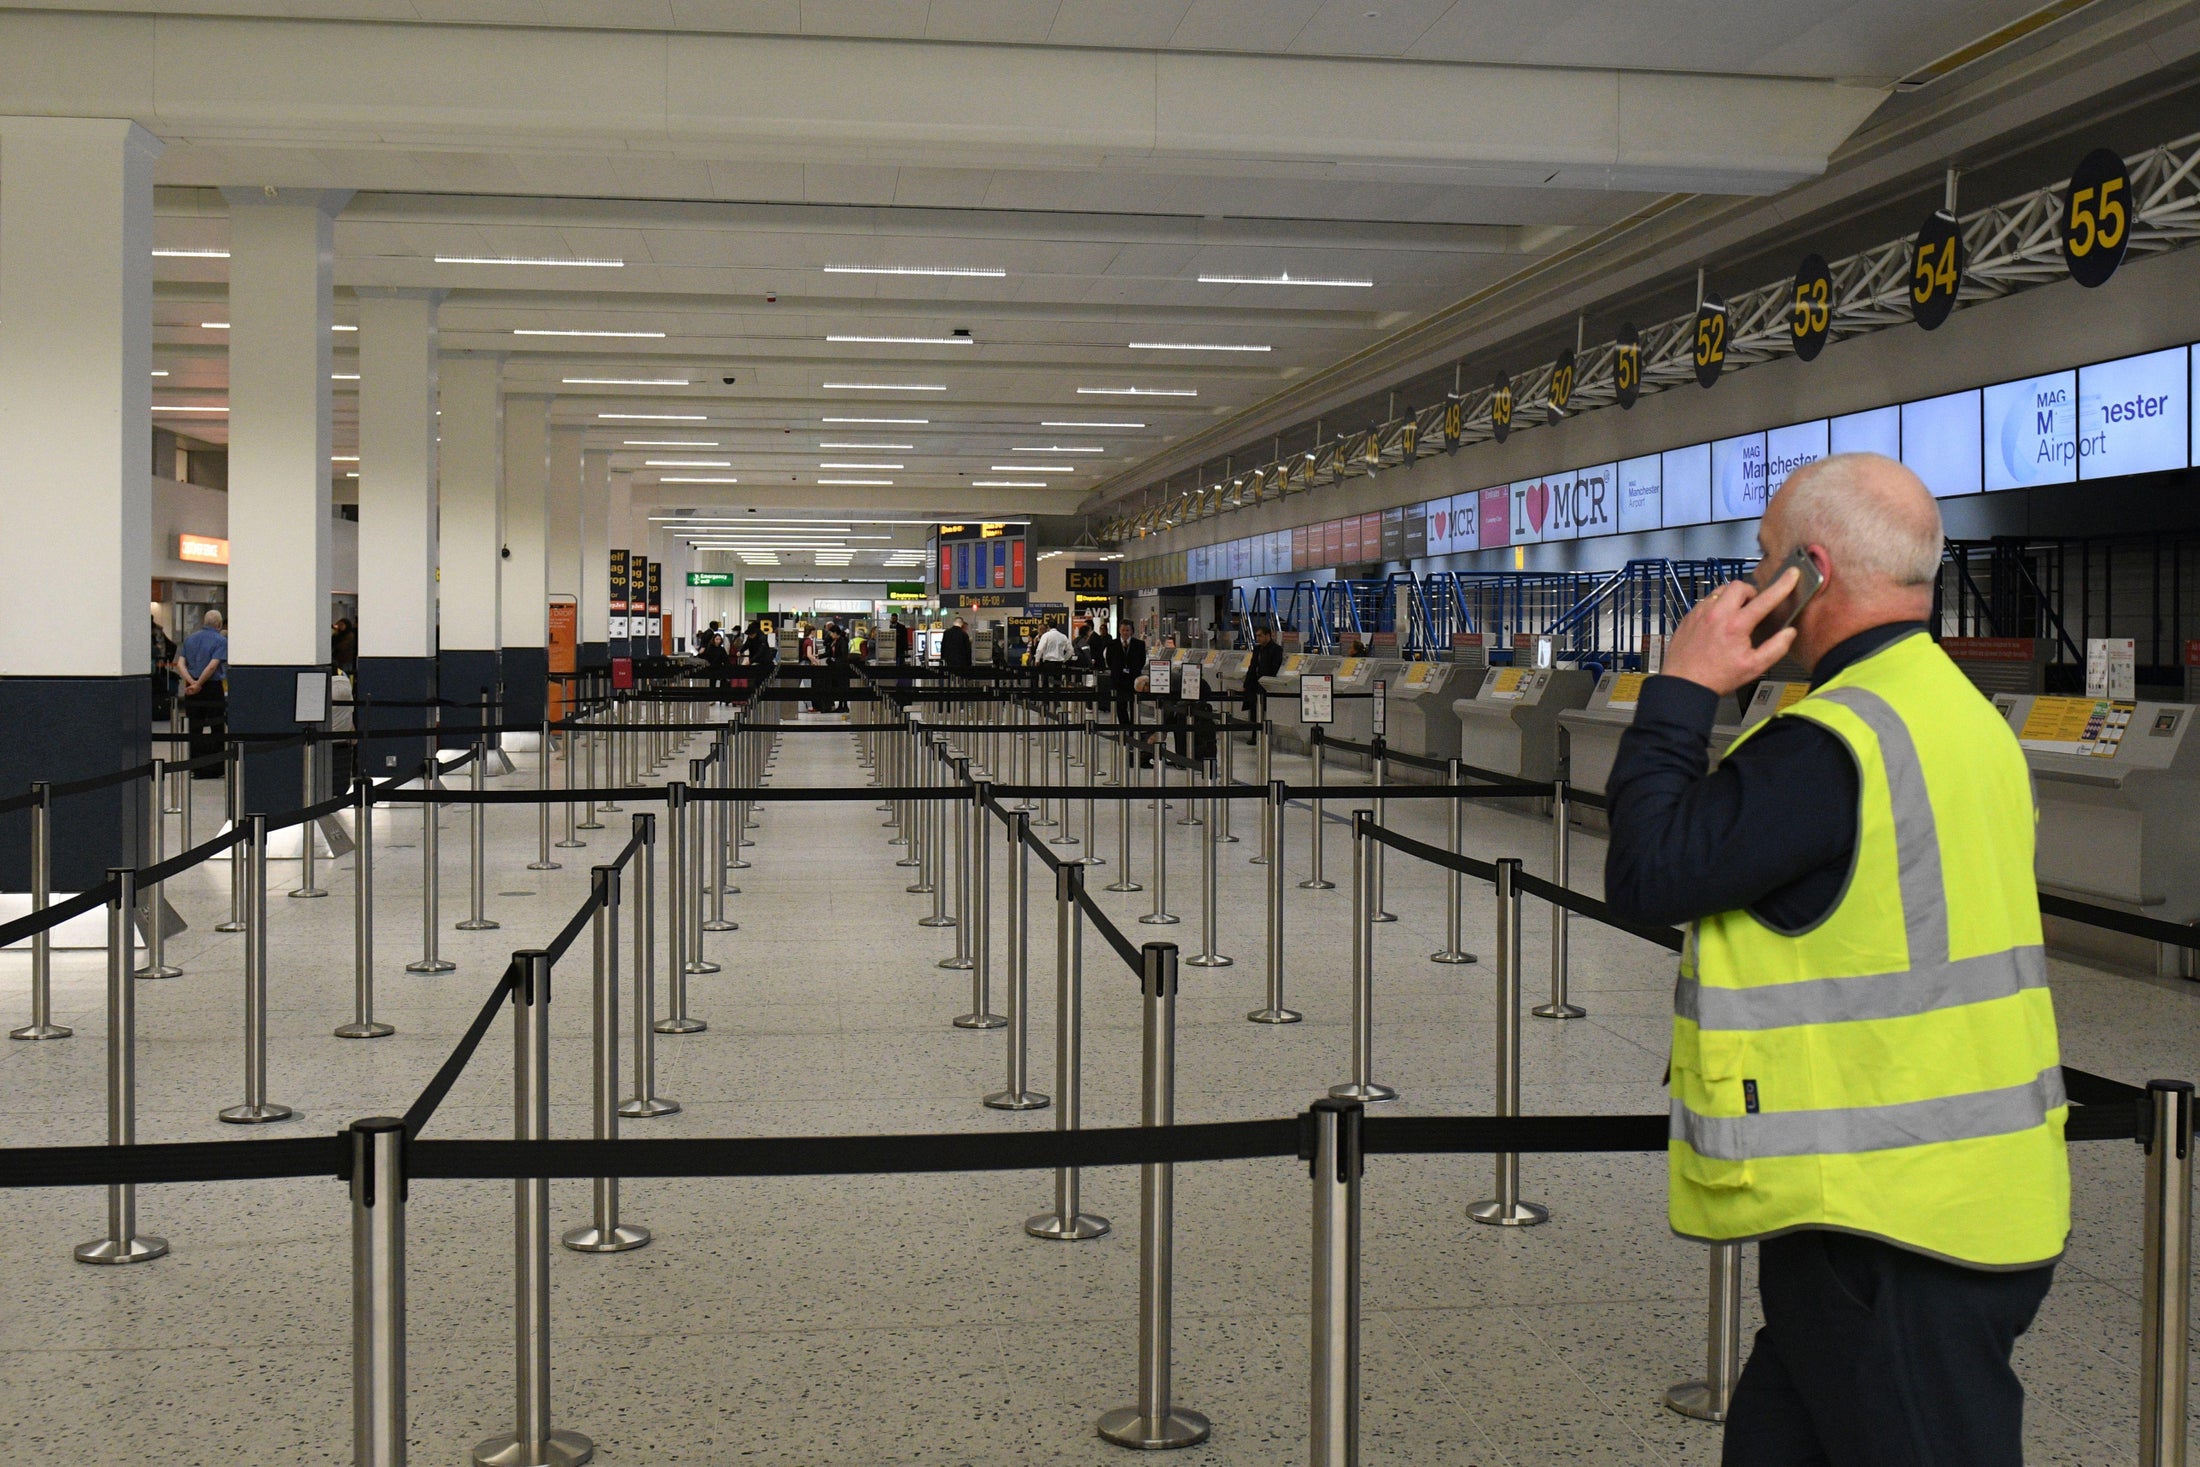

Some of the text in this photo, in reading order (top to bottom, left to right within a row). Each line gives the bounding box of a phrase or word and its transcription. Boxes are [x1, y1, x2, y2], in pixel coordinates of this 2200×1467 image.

[2068, 177, 2125, 257] 55
[1913, 236, 1957, 303] 54
[1793, 278, 1828, 337] 53
[1697, 313, 1725, 367] 52
[1618, 344, 1638, 389] 51
[1550, 365, 1572, 406] 50
[2037, 389, 2066, 408] MAG
[1445, 403, 1460, 438] 48
[1493, 385, 1511, 425] 49
[1366, 433, 1379, 464] 46
[1403, 422, 1416, 454] 47
[1743, 445, 1760, 460] MAG
[2037, 430, 2106, 466] Airport
[1743, 453, 1817, 480] Manchester
[1515, 476, 1608, 534] I MCR
[1629, 485, 1659, 497] Manchester
[1448, 507, 1475, 538] MCR
[611, 552, 624, 561] elf
[611, 565, 624, 574] ag
[610, 577, 626, 586] op
[632, 581, 644, 589] op
[1070, 573, 1105, 588] Exit
[1009, 617, 1042, 625] Security
